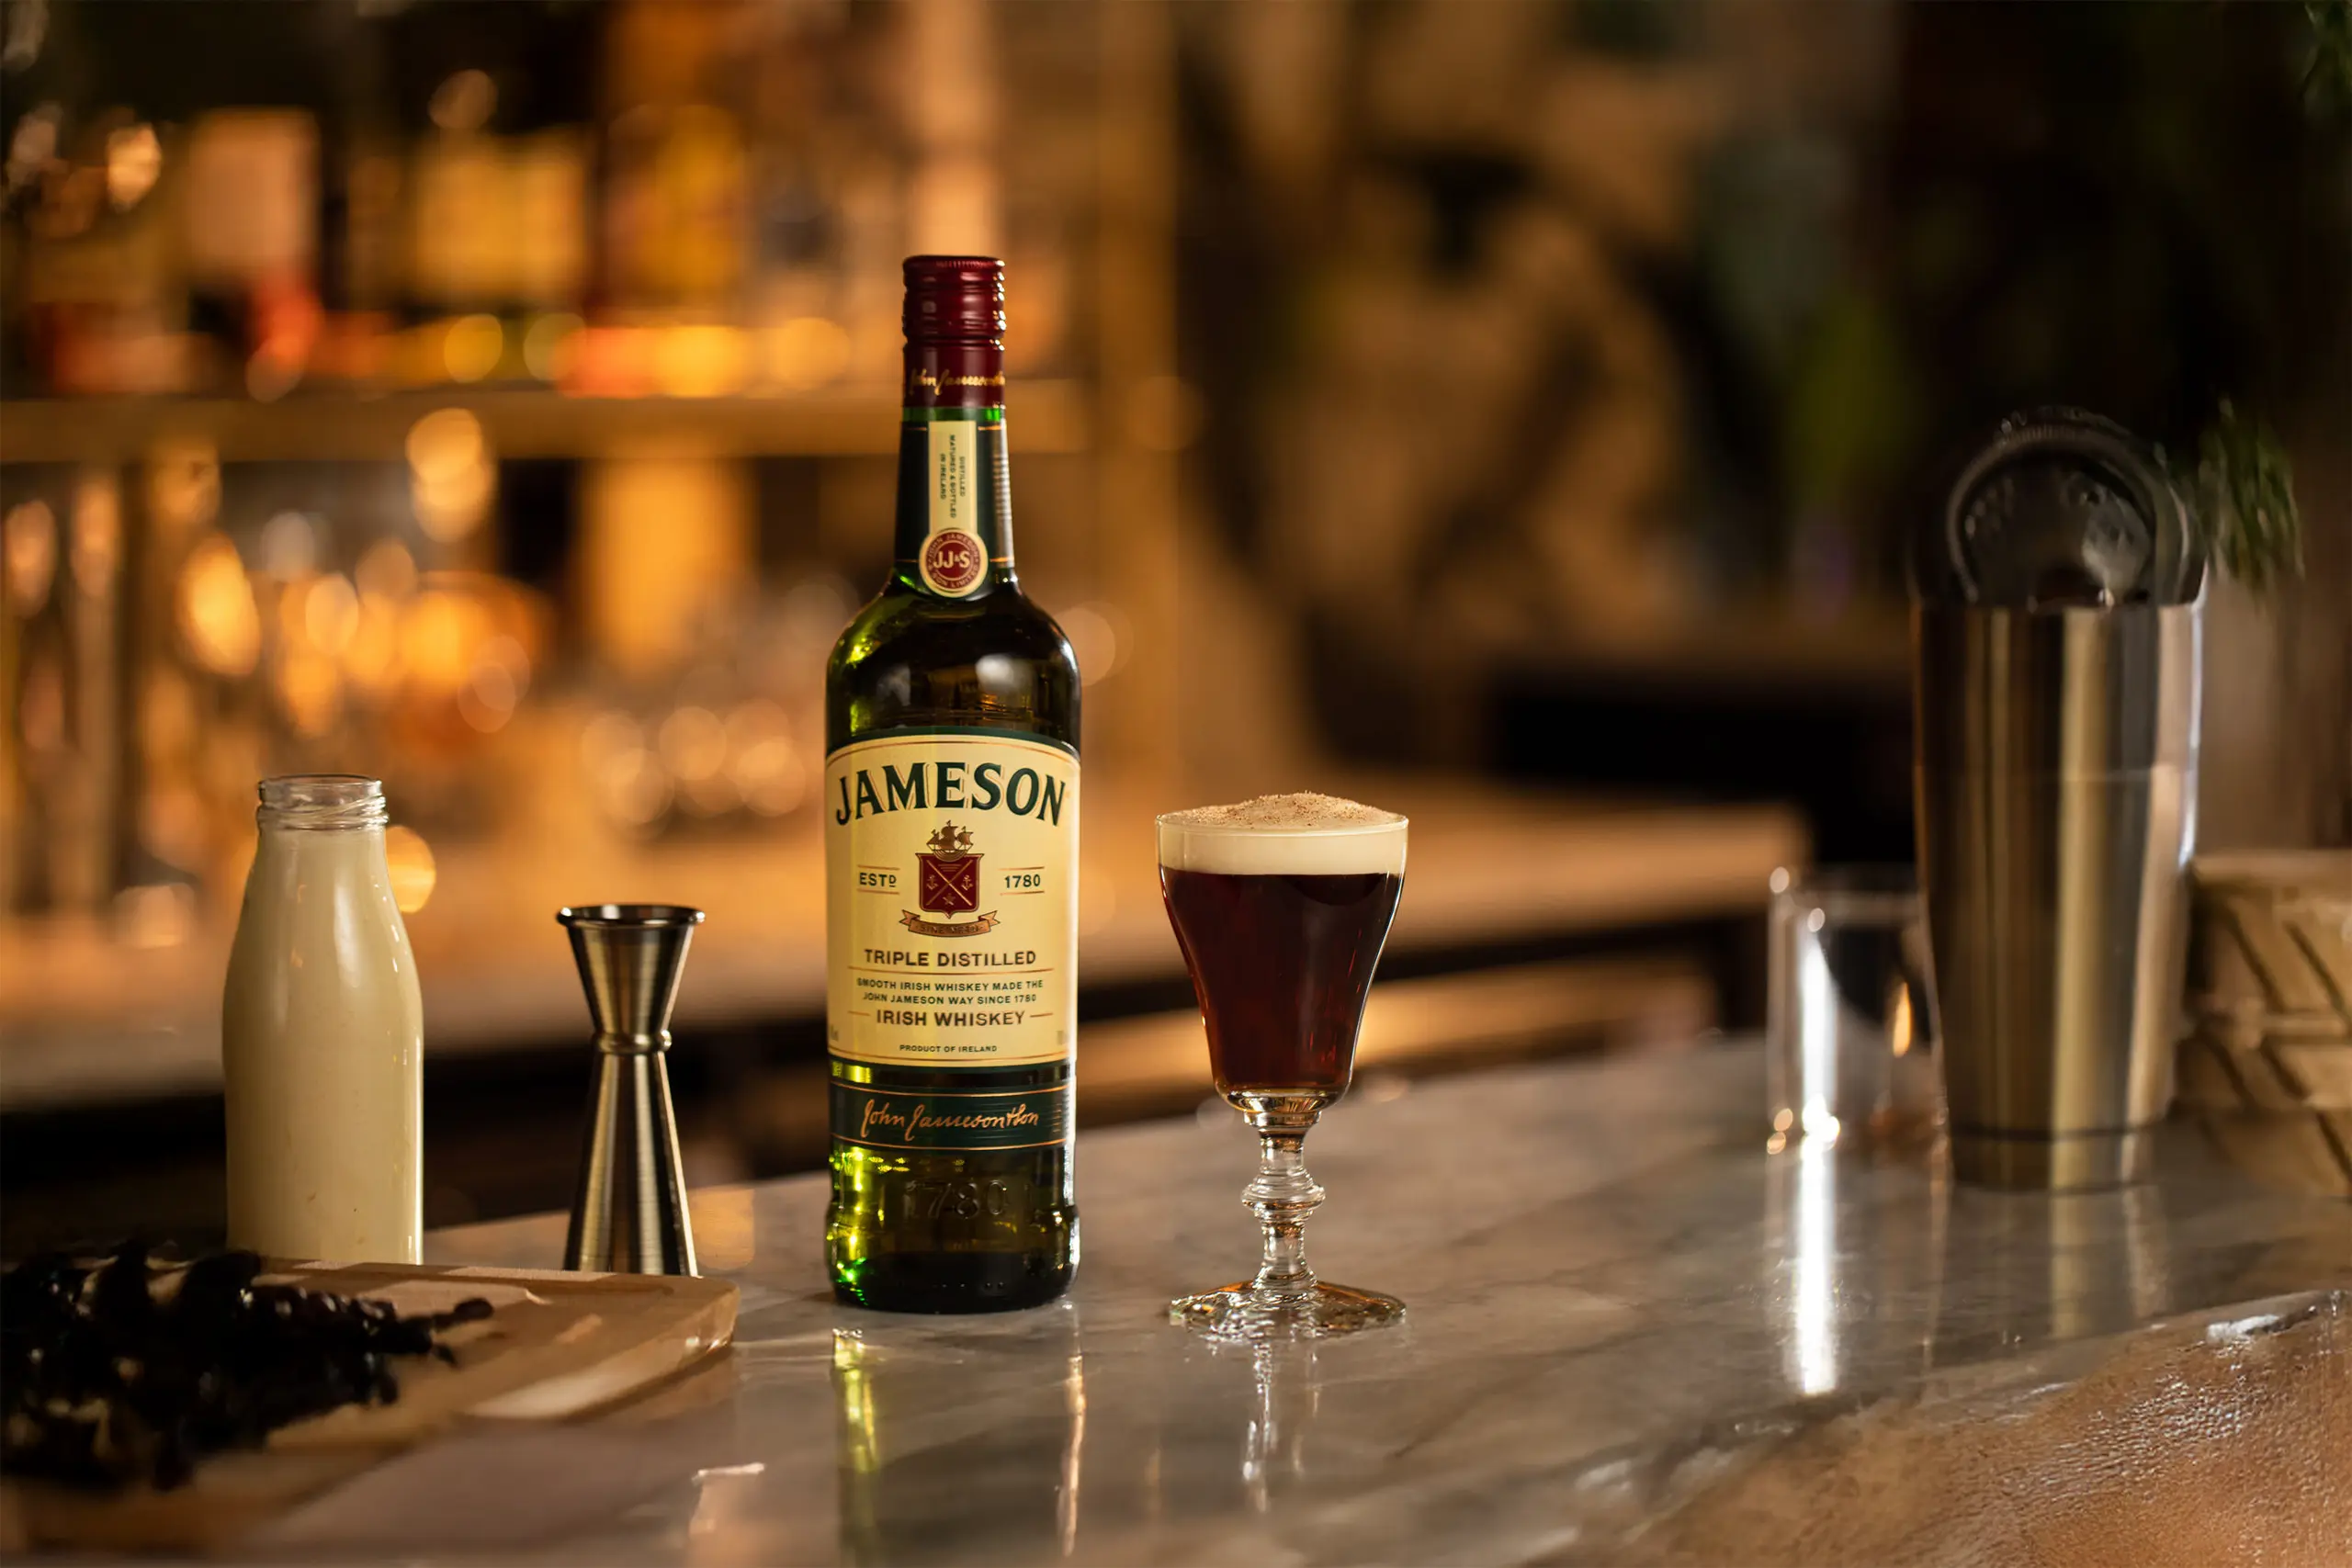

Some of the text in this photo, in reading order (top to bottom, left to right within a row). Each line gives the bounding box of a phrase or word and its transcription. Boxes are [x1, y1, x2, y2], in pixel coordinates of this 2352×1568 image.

[949, 434, 957, 473] MATURED
[835, 761, 1066, 827] JAMESON
[1004, 874, 1041, 888] 1780
[865, 948, 1036, 967] TRIPLE DISTILLED
[857, 977, 1044, 991] SMOOTH IRISH WHISKEY MADE THE
[862, 992, 1037, 1005] JOHN JAMESON WAY SINCE 1780
[876, 1010, 1025, 1027] IRISH WHISKEY
[899, 1044, 998, 1053] PRODUCT OF IRELAND
[860, 1099, 905, 1139] John
